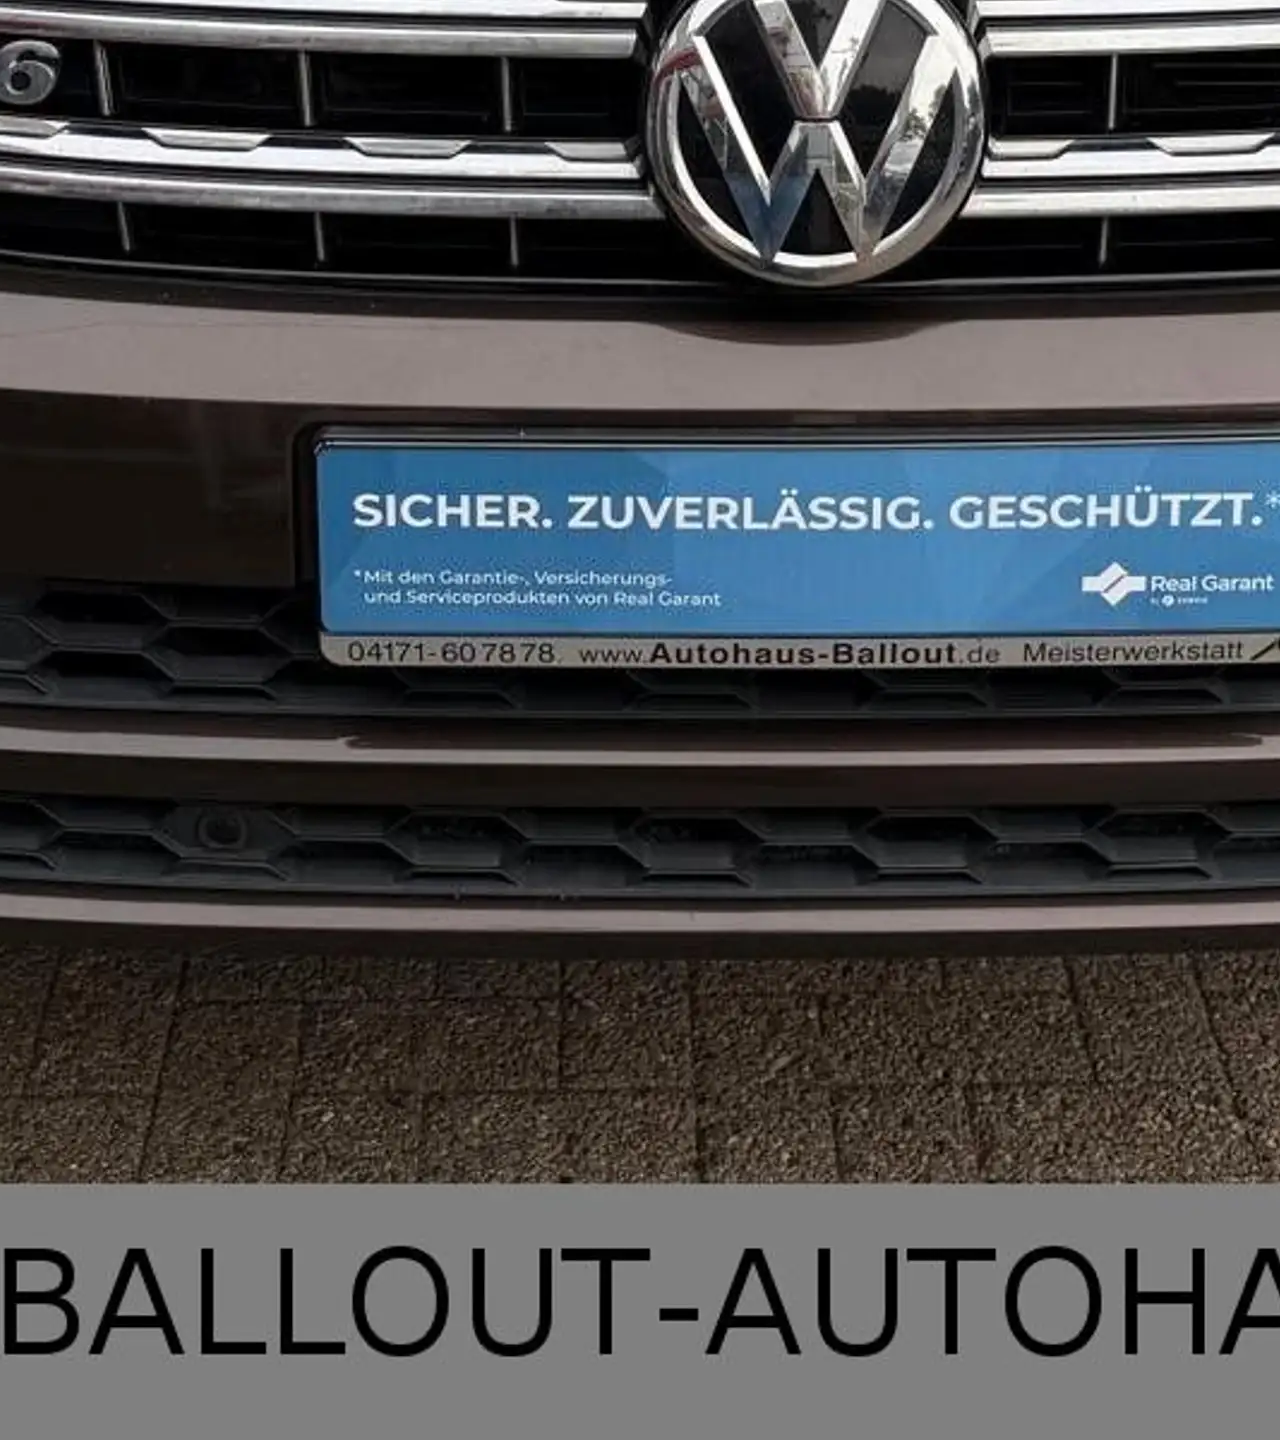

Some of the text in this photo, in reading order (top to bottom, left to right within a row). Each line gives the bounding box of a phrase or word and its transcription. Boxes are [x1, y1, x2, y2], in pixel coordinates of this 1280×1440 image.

[352, 493, 553, 529] SICHER.
[566, 488, 934, 531] ZUVERLÄSSIG.
[398, 569, 435, 586] den
[534, 569, 673, 590] Versicherungs-
[1150, 573, 1275, 592] Real Garant
[363, 586, 722, 607] und Serviceprodukten von Real Garant
[578, 640, 1002, 666] www.Autohaus-Ballout.de
[1022, 639, 1244, 664] Meisterwerkstatt
